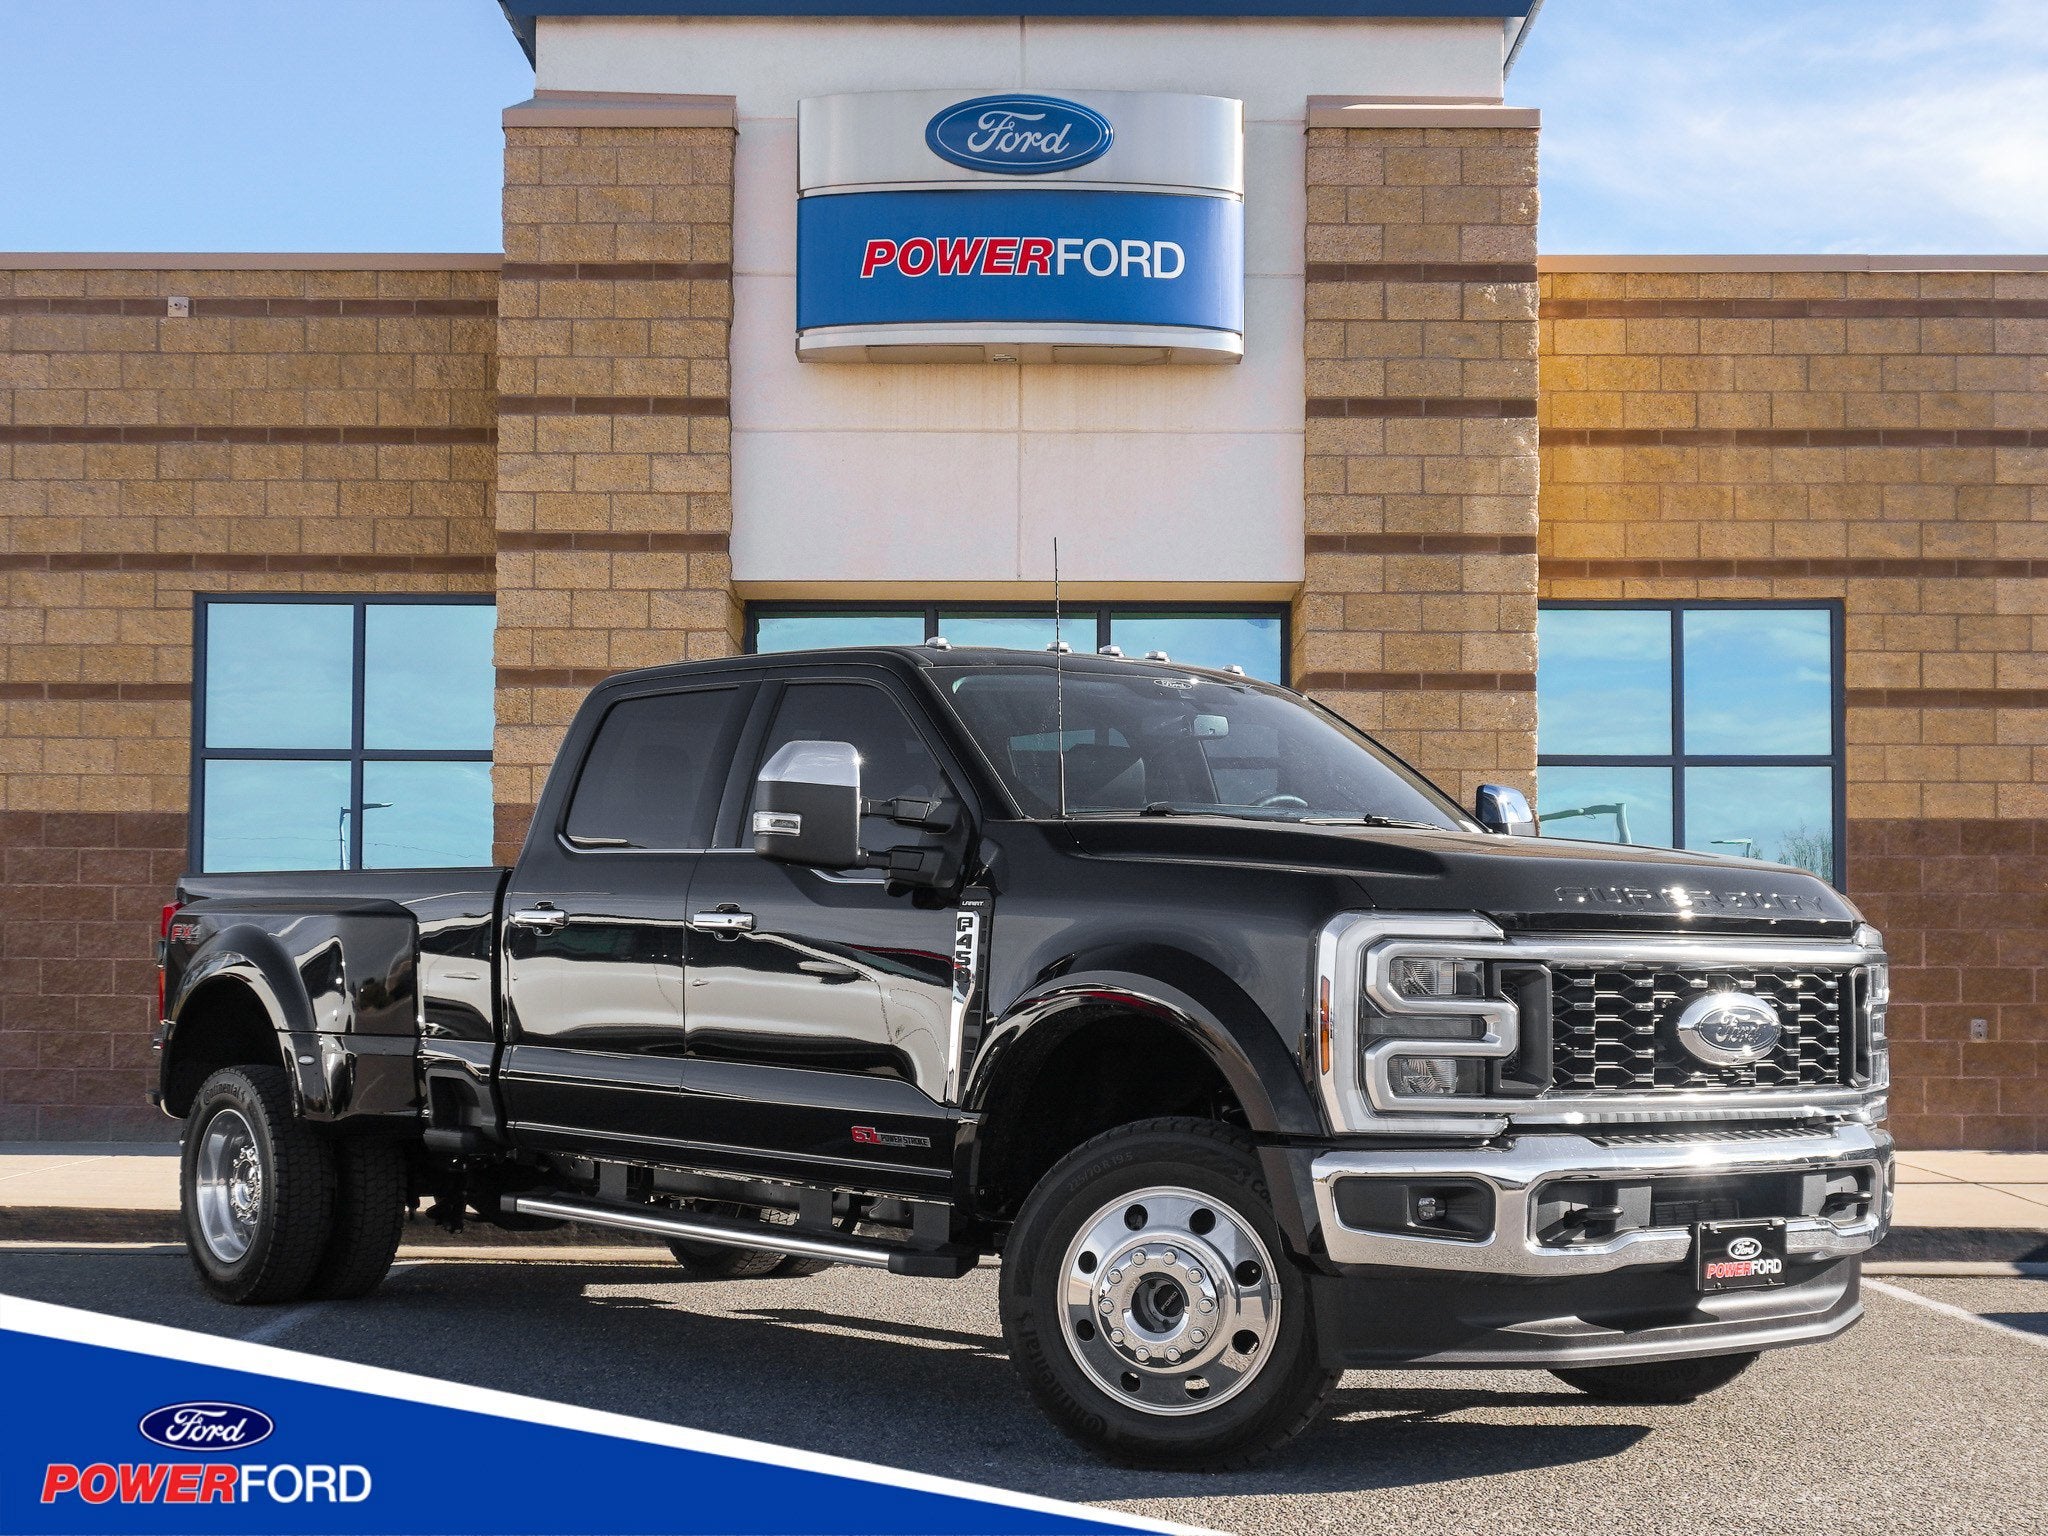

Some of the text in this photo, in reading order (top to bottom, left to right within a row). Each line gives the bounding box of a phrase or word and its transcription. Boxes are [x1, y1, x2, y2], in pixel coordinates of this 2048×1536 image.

[968, 110, 1072, 154] Ford
[860, 237, 1186, 279] POWERFORD
[171, 923, 201, 944] FX4
[1716, 1011, 1761, 1043] Ford
[1735, 1240, 1756, 1255] Ford
